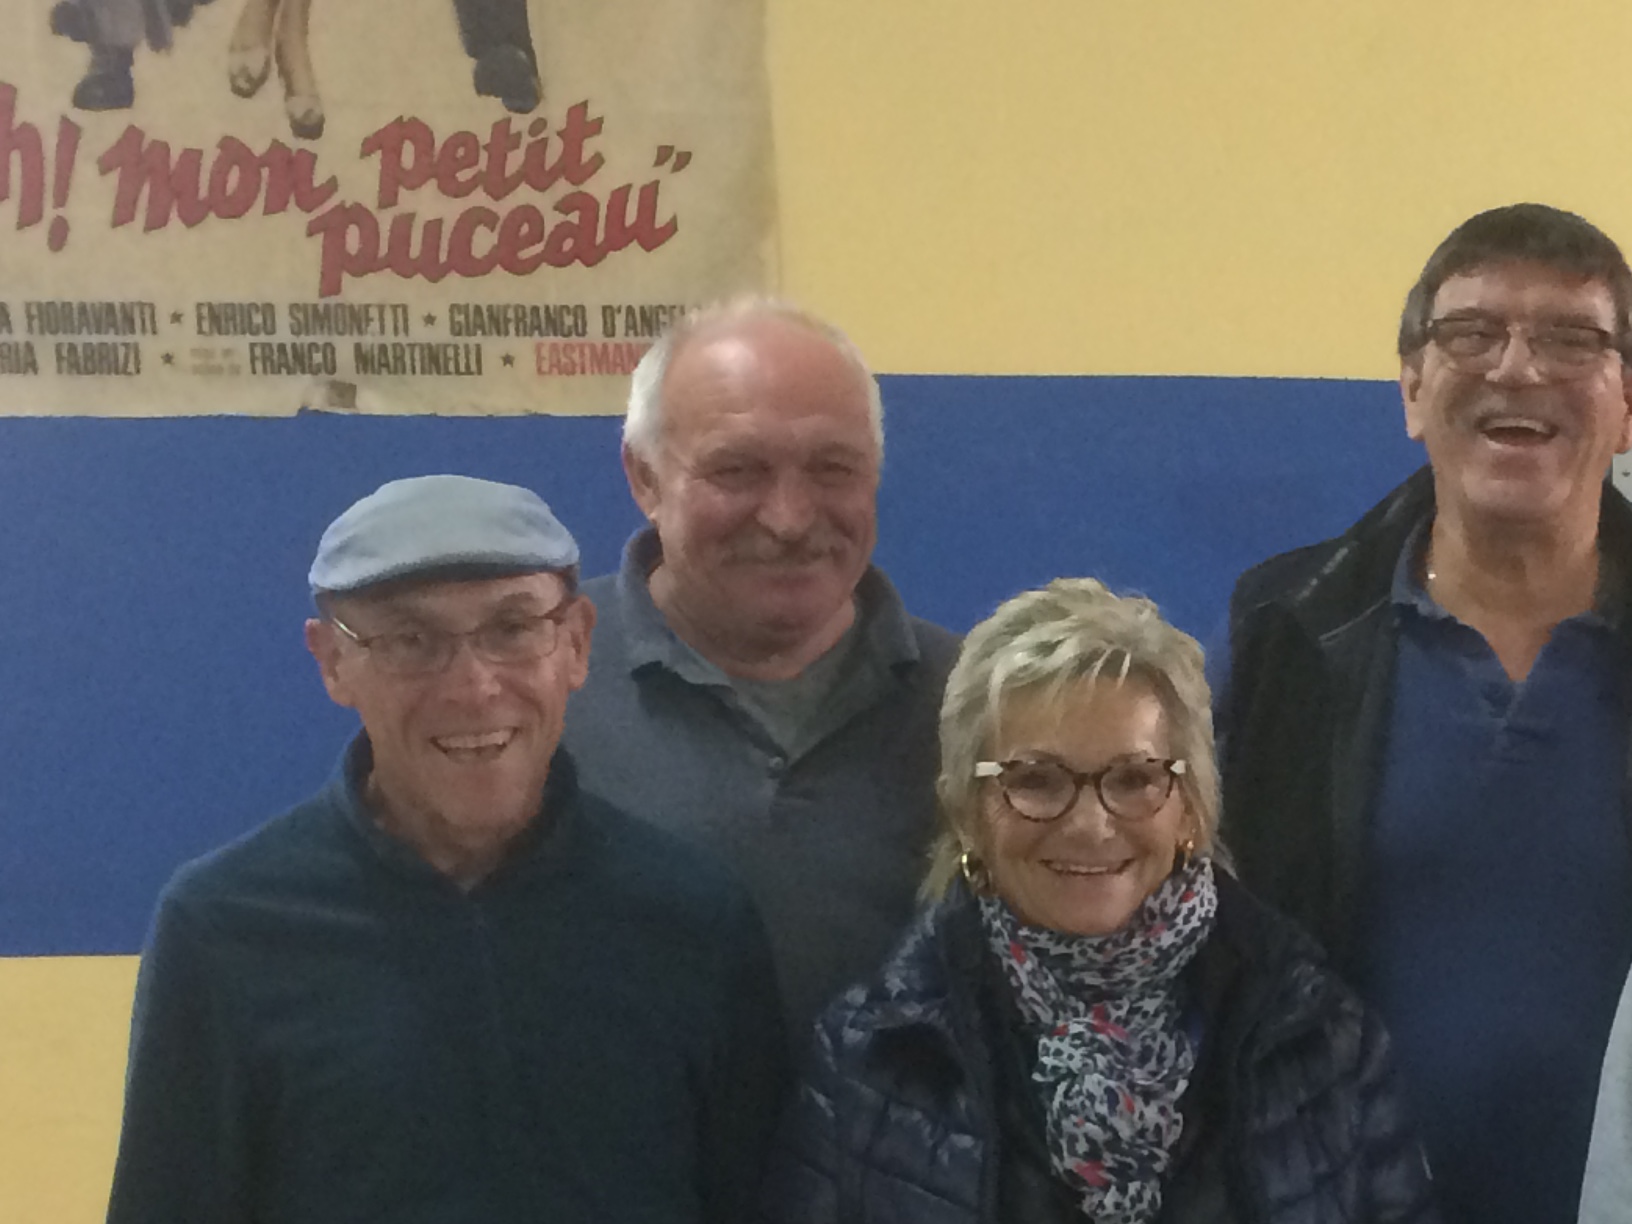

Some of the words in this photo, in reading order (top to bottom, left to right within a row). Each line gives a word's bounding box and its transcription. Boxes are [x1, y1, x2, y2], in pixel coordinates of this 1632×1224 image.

[97, 124, 338, 233] mon
[360, 100, 605, 209] petit
[25, 302, 157, 335] FIORAVANTI
[196, 303, 275, 336] ENRICO
[289, 303, 409, 336] SIMONETTI
[449, 303, 587, 337] GIANFRANCO
[55, 342, 141, 375] FABRIZI
[249, 342, 336, 375] FRANCO
[354, 342, 482, 376] MARTINELLI
